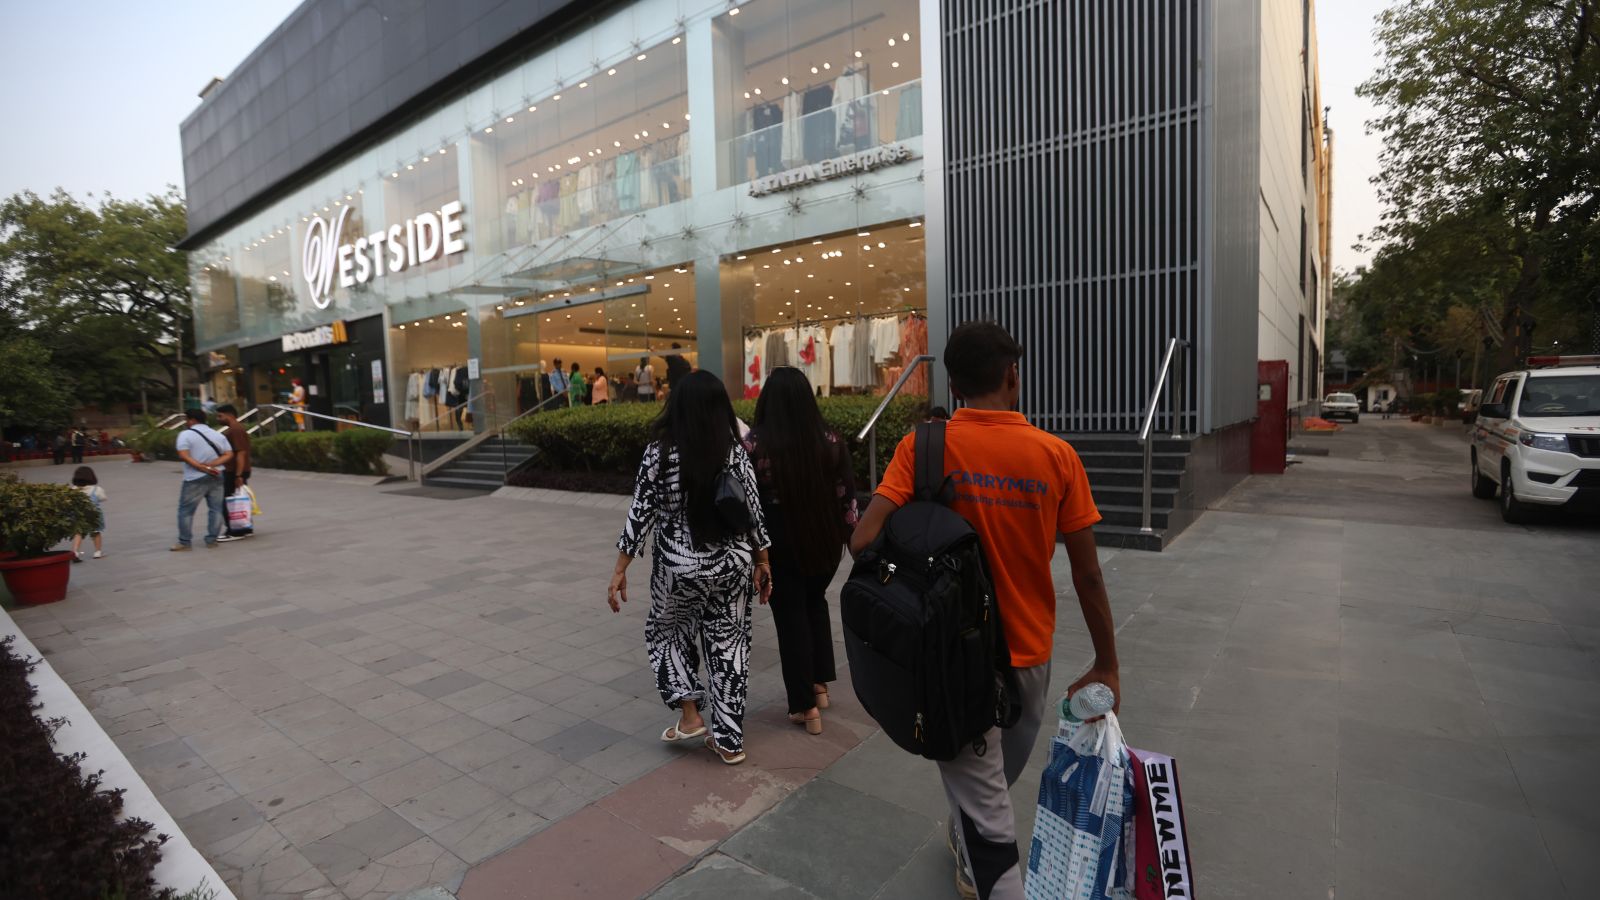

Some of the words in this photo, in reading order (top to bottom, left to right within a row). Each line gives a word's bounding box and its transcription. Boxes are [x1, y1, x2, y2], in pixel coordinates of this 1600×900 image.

[761, 165, 816, 191] TATA
[819, 143, 908, 178] Enterprise
[303, 200, 465, 310] WESTSIDE
[951, 469, 1049, 496] CARRYMEN
[1146, 762, 1185, 898] NEWME
